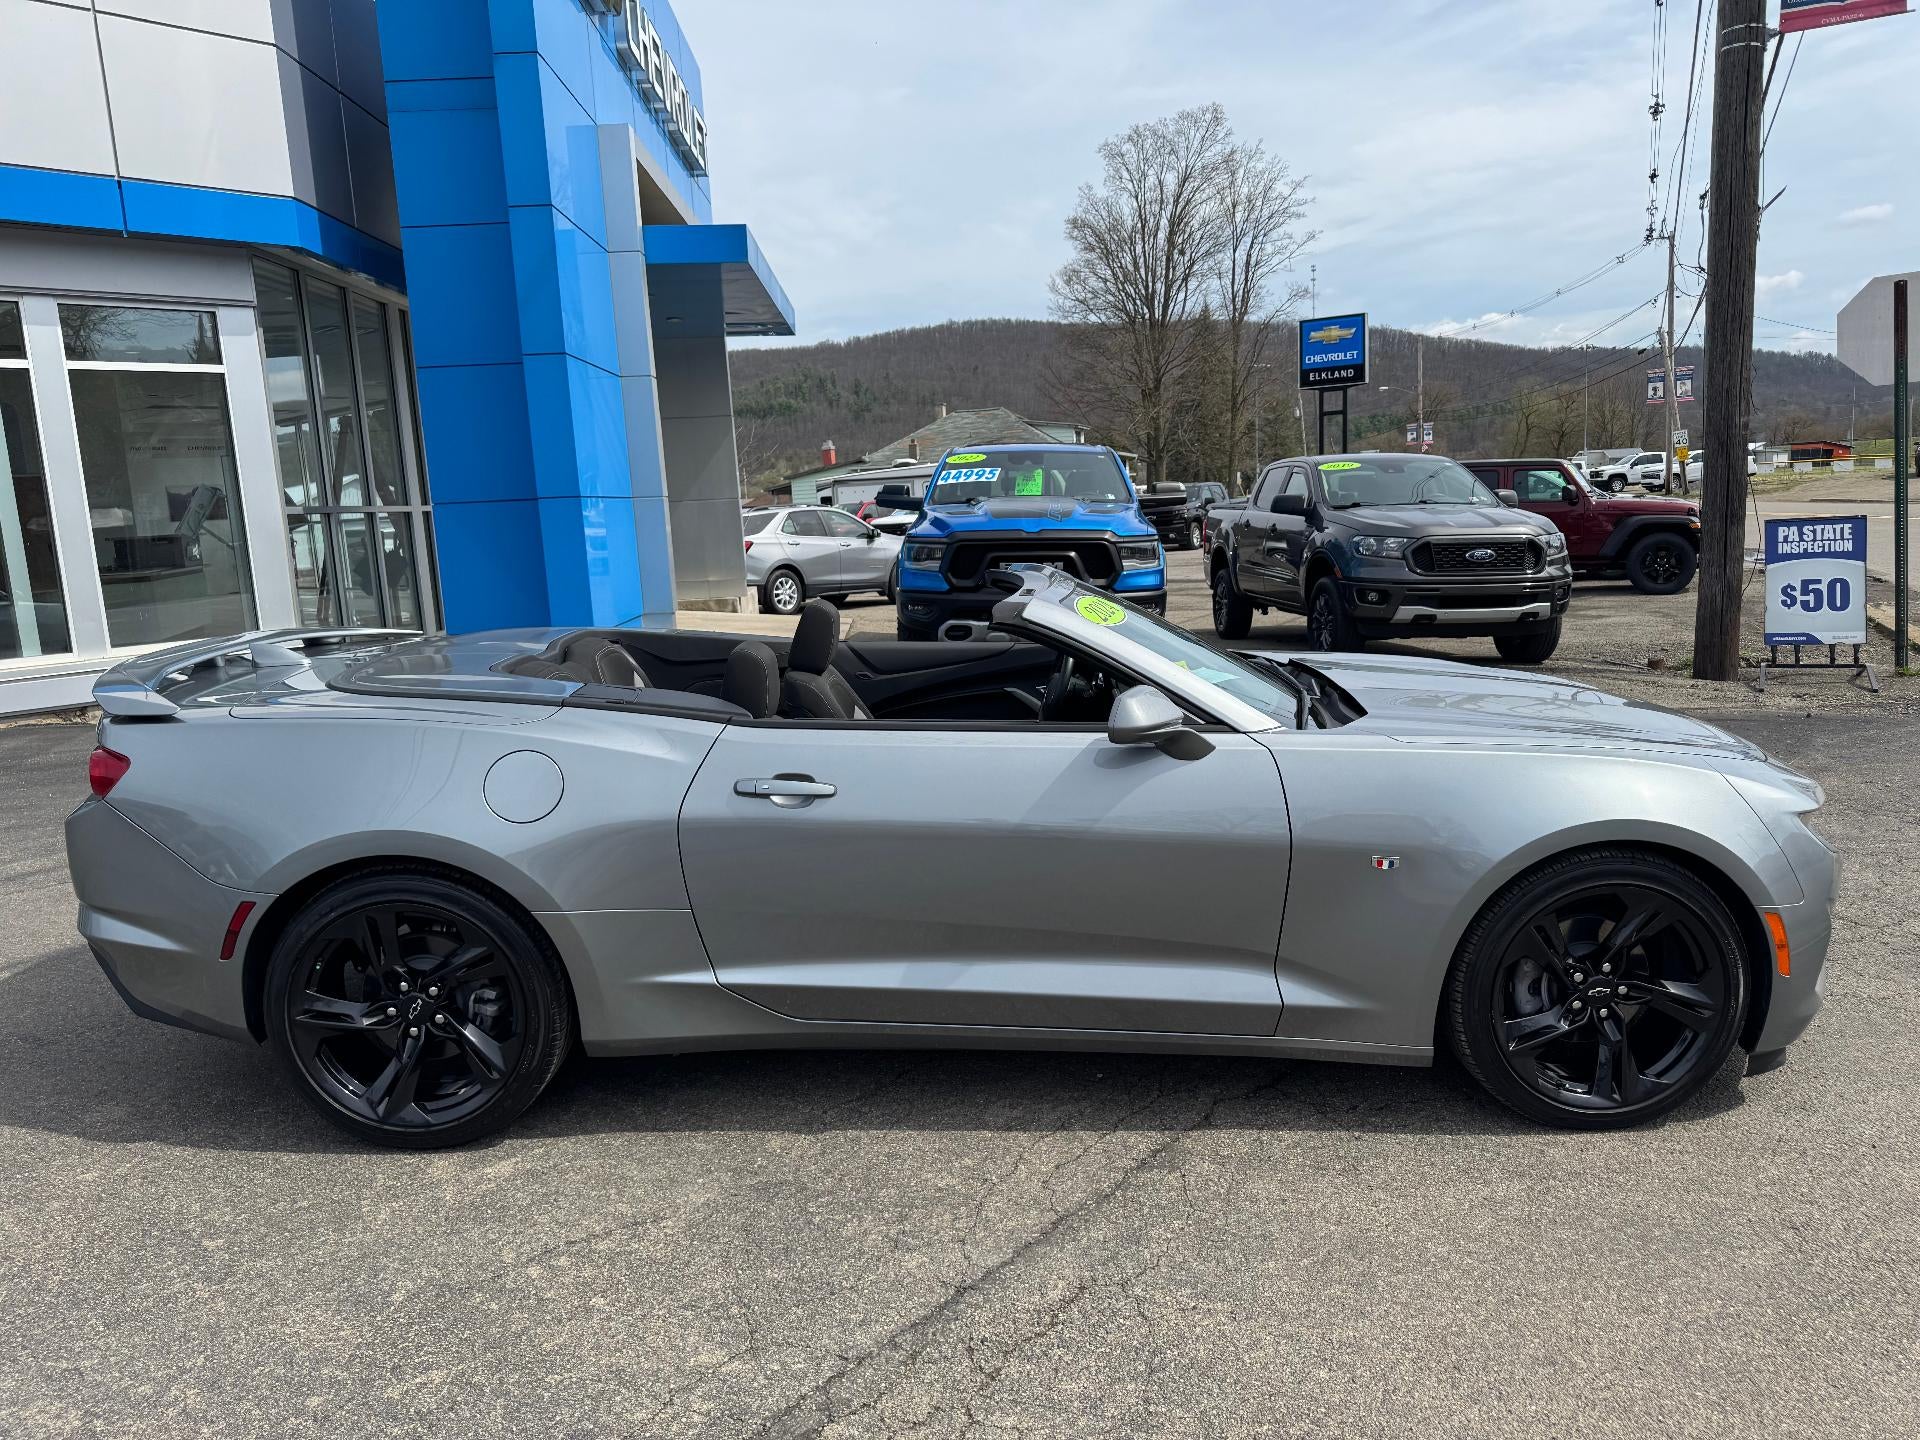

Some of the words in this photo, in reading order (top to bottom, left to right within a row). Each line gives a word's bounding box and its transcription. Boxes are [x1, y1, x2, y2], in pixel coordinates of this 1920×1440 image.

[1305, 350, 1359, 363] CHEVROLET
[1309, 369, 1354, 381] ELKLAND
[940, 469, 1000, 483] 44995
[1778, 526, 1799, 542] PA
[1802, 524, 1853, 541] STATE
[1778, 540, 1853, 554] INSPECTION
[1780, 577, 1851, 613] $50
